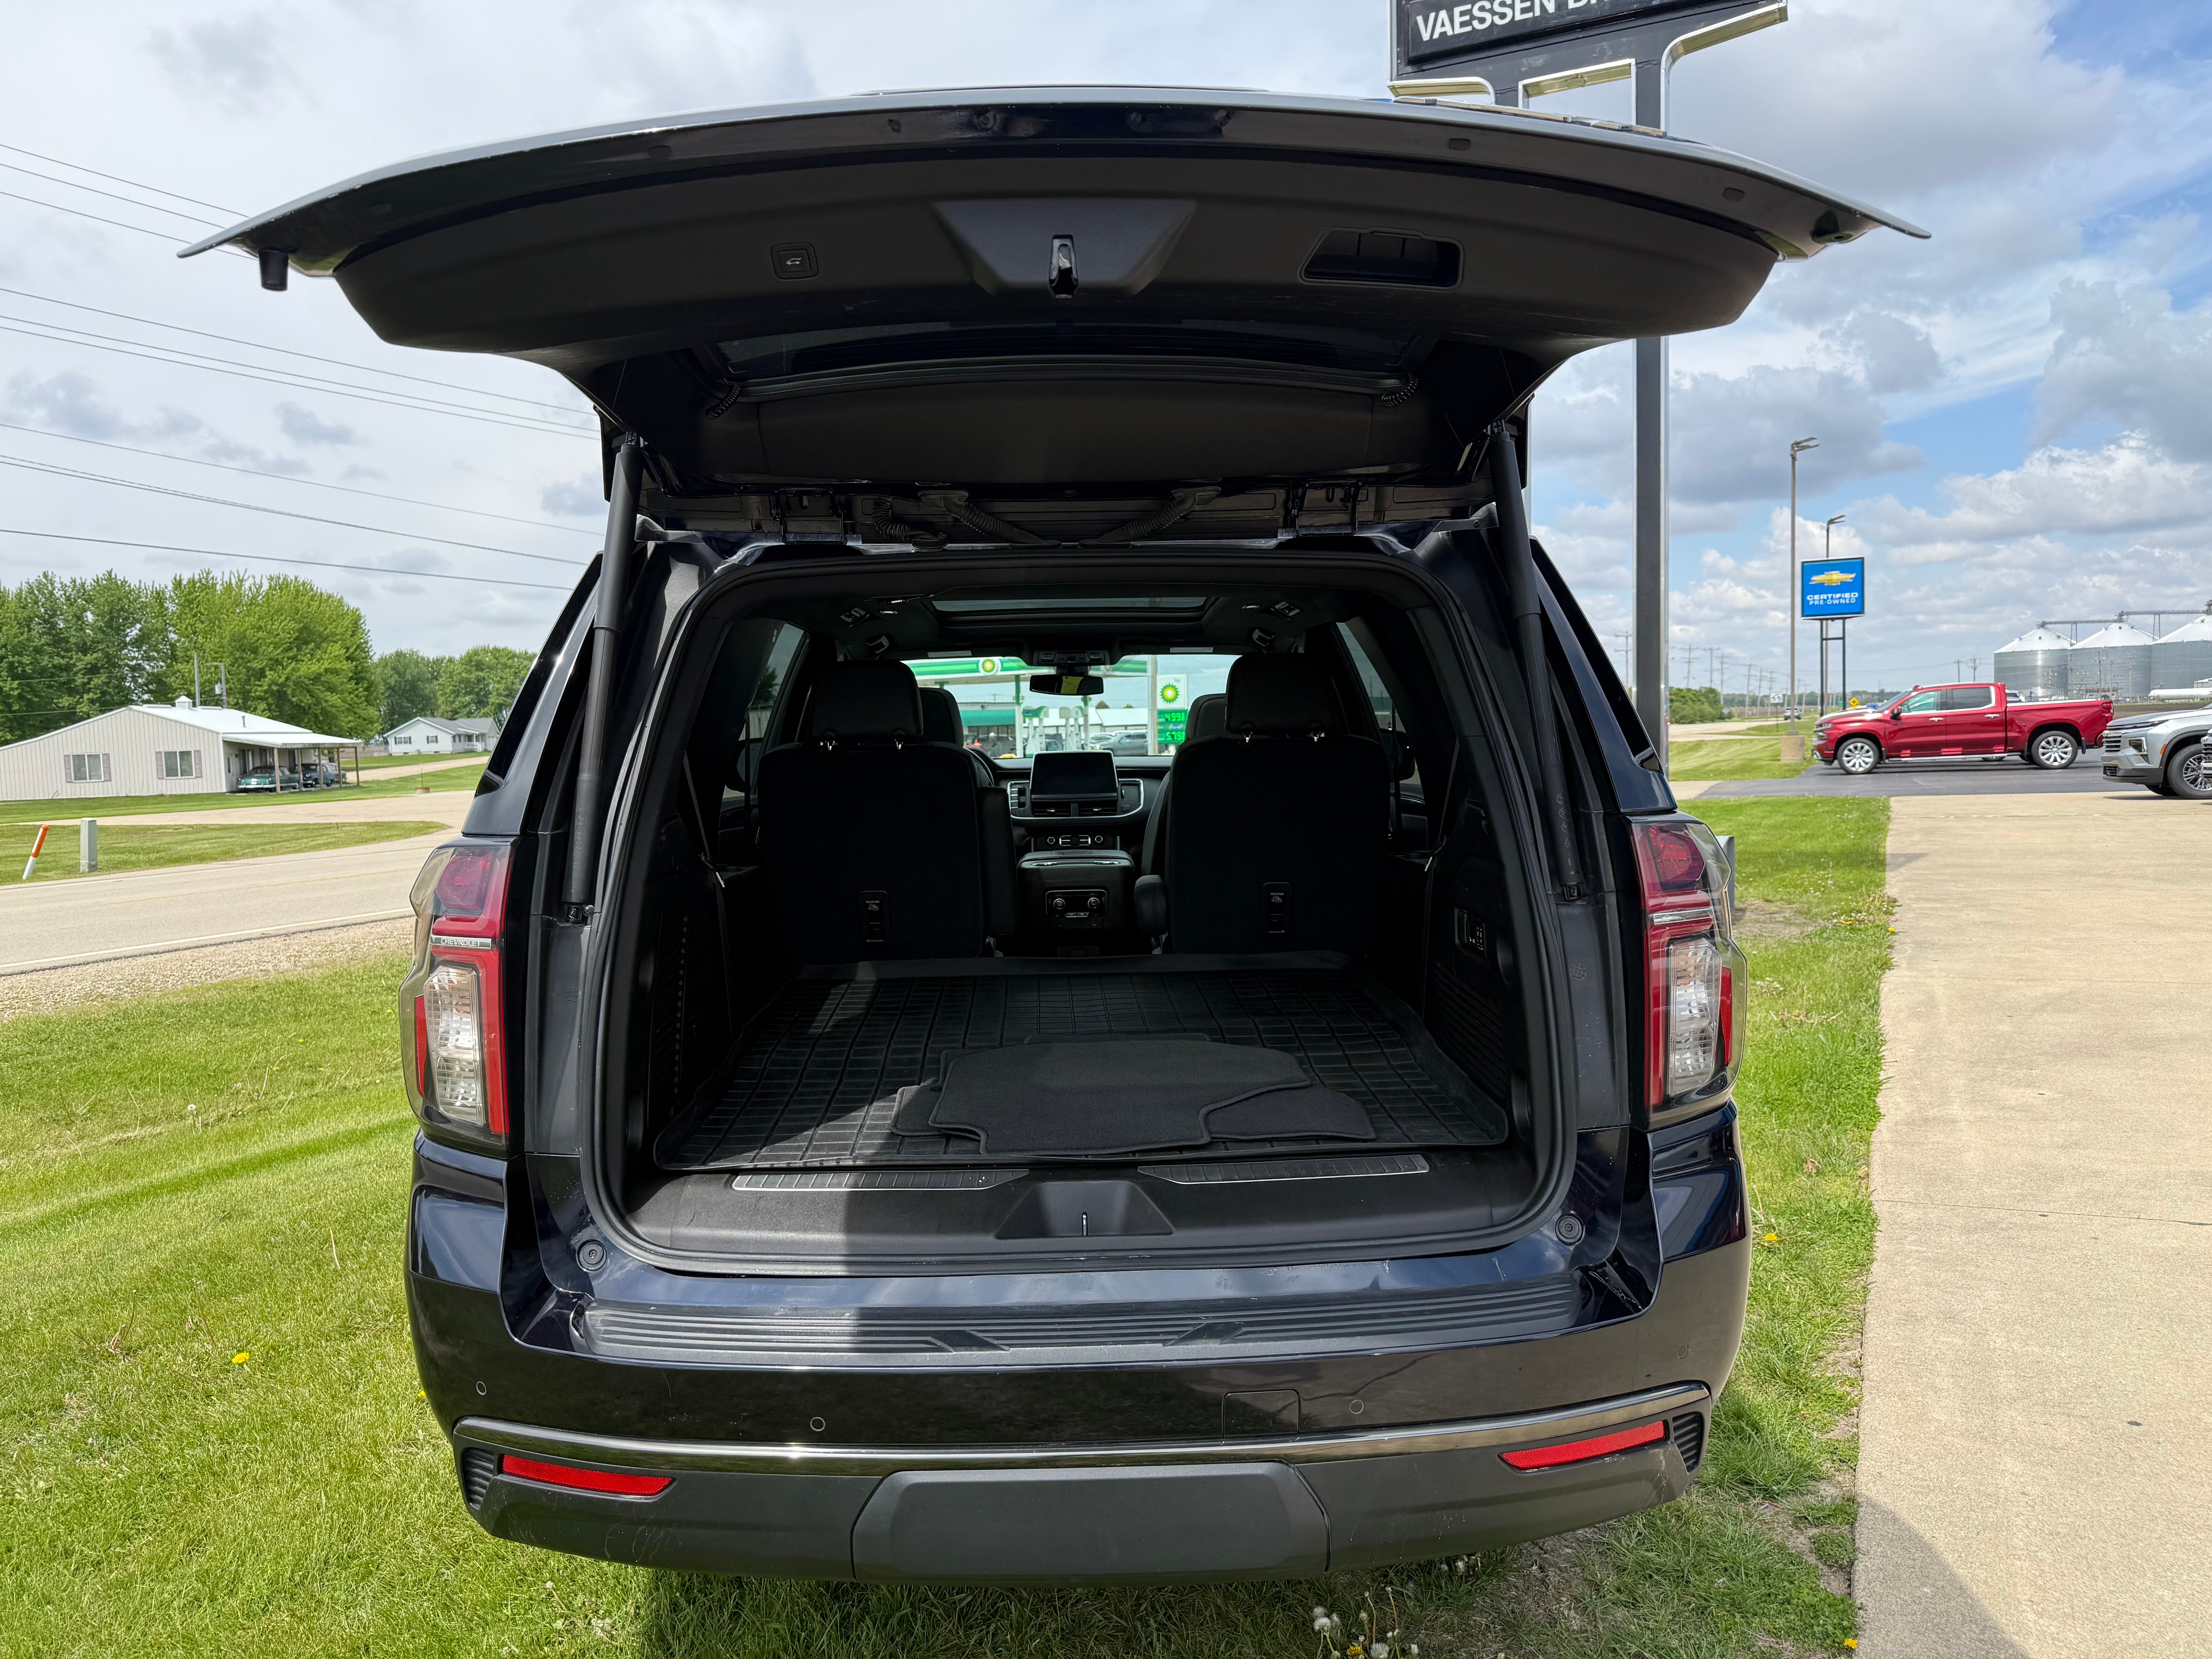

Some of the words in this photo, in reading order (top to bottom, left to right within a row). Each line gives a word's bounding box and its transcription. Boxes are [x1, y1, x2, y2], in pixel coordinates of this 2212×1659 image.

[1416, 0, 1555, 41] VAESSEN
[1807, 592, 1858, 600] CERTIFIED
[441, 938, 480, 947] CHEVROLET
